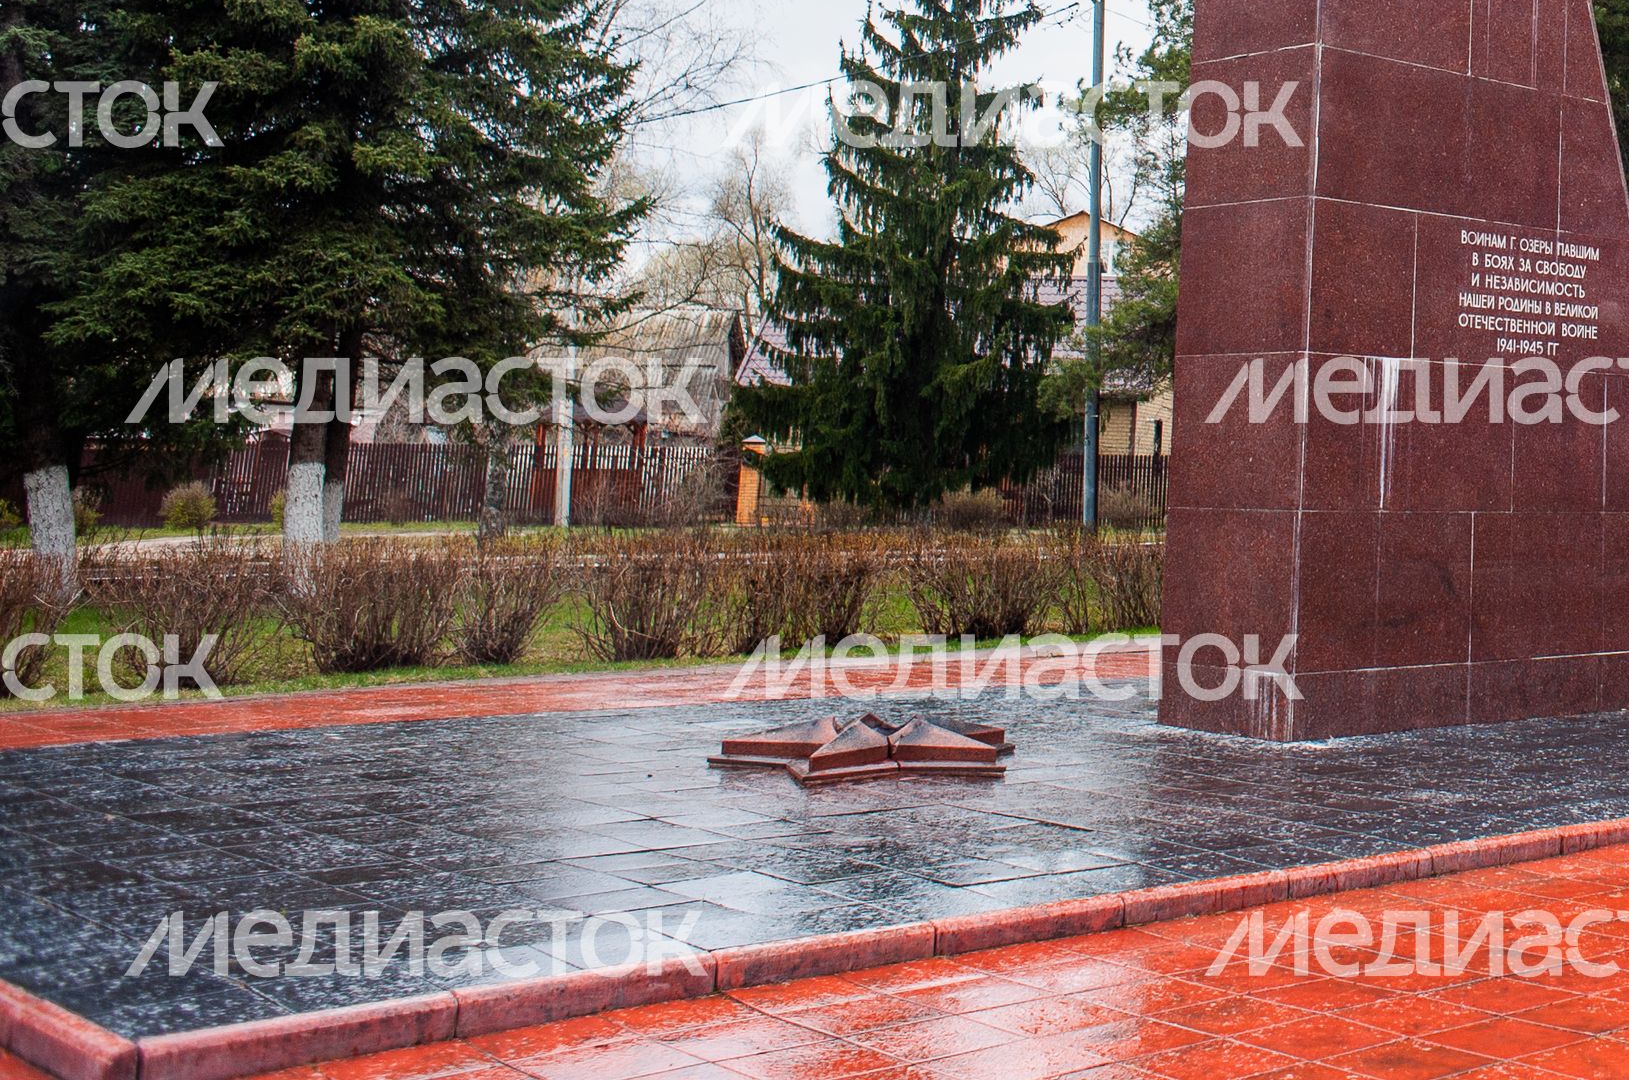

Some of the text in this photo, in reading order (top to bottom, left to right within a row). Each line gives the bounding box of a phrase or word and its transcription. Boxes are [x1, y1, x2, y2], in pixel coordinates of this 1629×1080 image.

[1461, 230, 1600, 261] ВОИНАМ Г. ОЗЕРЫ ПАВШИМ
[1472, 252, 1587, 279] В БОЯХ ЗА СВОБОДУ
[1471, 272, 1586, 299] И НЕЗАВИСИМОСТЬ
[1459, 292, 1599, 320] НАШЕЙ РОДИНЫ В ВЕЛИКОЙ
[1458, 313, 1598, 340] ОТЕЧЕСТВЕННОЙ ВОЙНЕ
[1497, 338, 1560, 357] 1941-1945 ГГ
